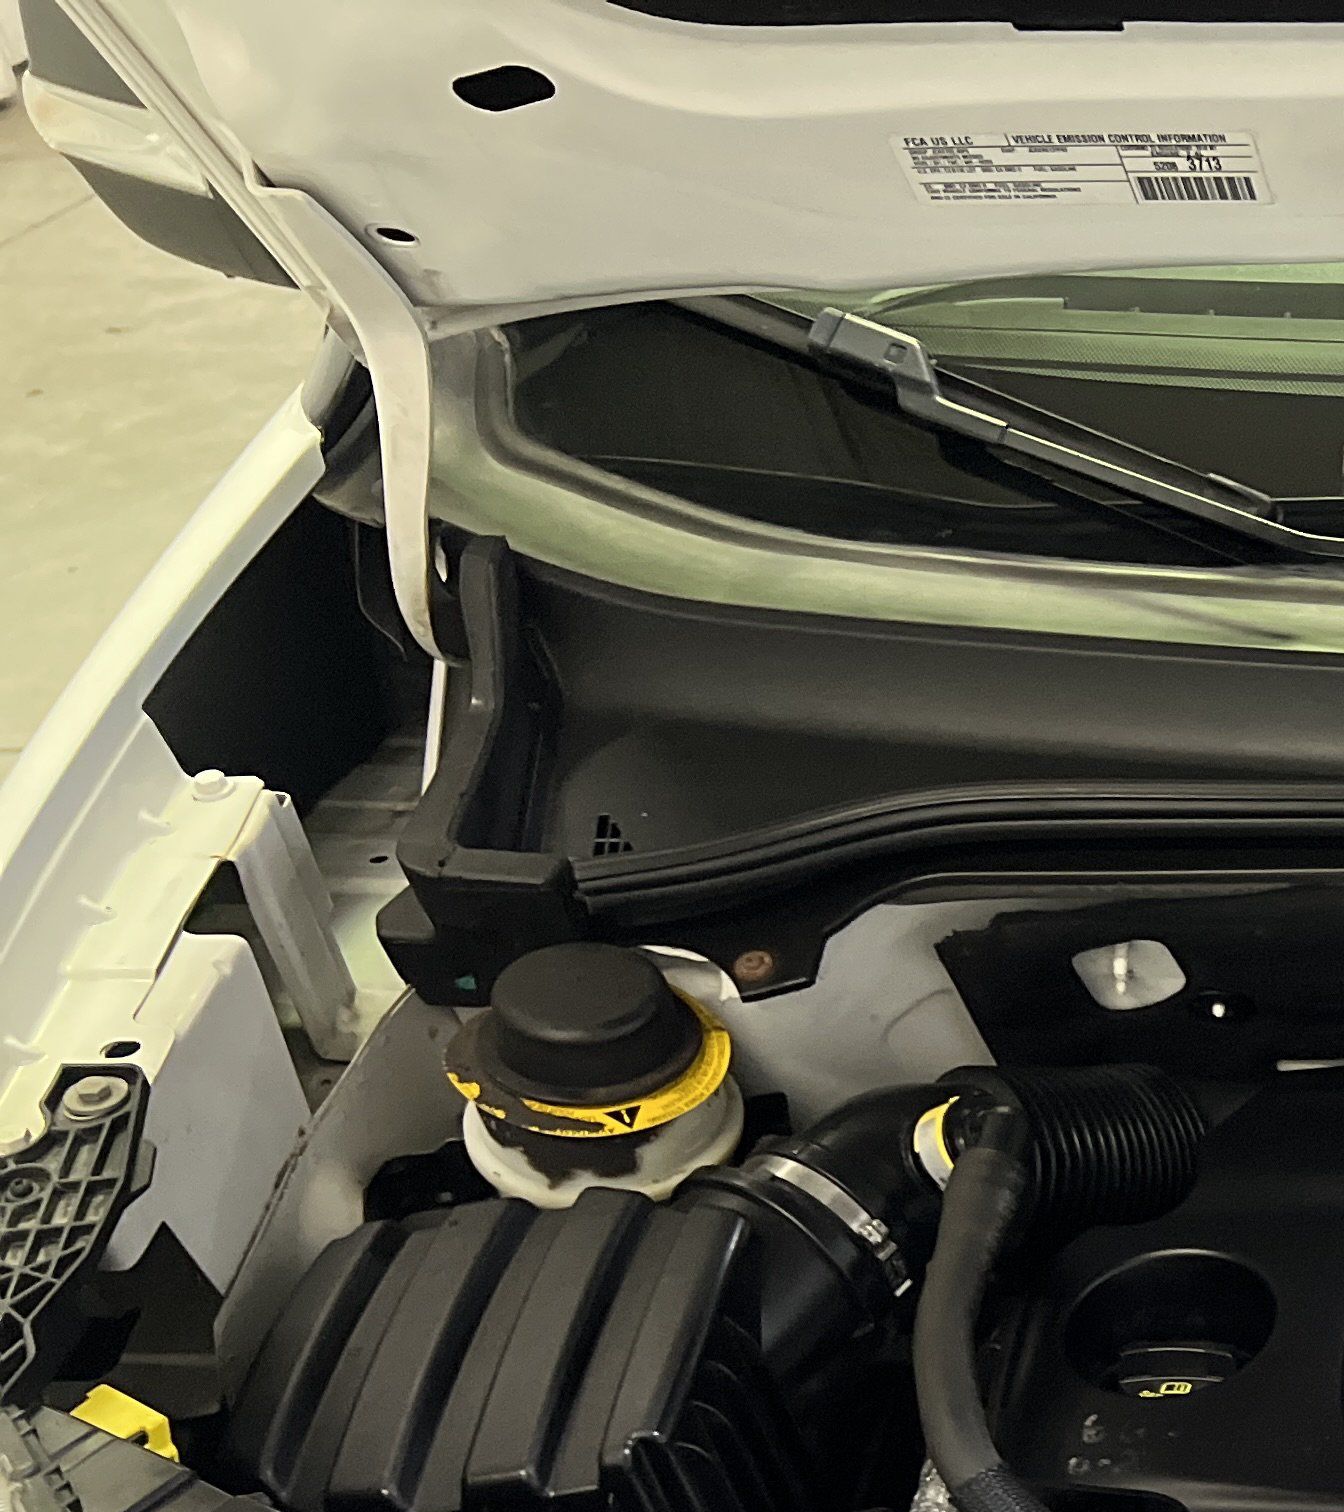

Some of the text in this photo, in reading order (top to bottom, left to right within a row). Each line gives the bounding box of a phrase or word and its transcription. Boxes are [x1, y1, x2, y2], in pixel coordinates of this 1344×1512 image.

[903, 136, 973, 147] FCA US LLC
[1011, 134, 1226, 145] VEHICLE EMISSION CONTROL INFORMATION
